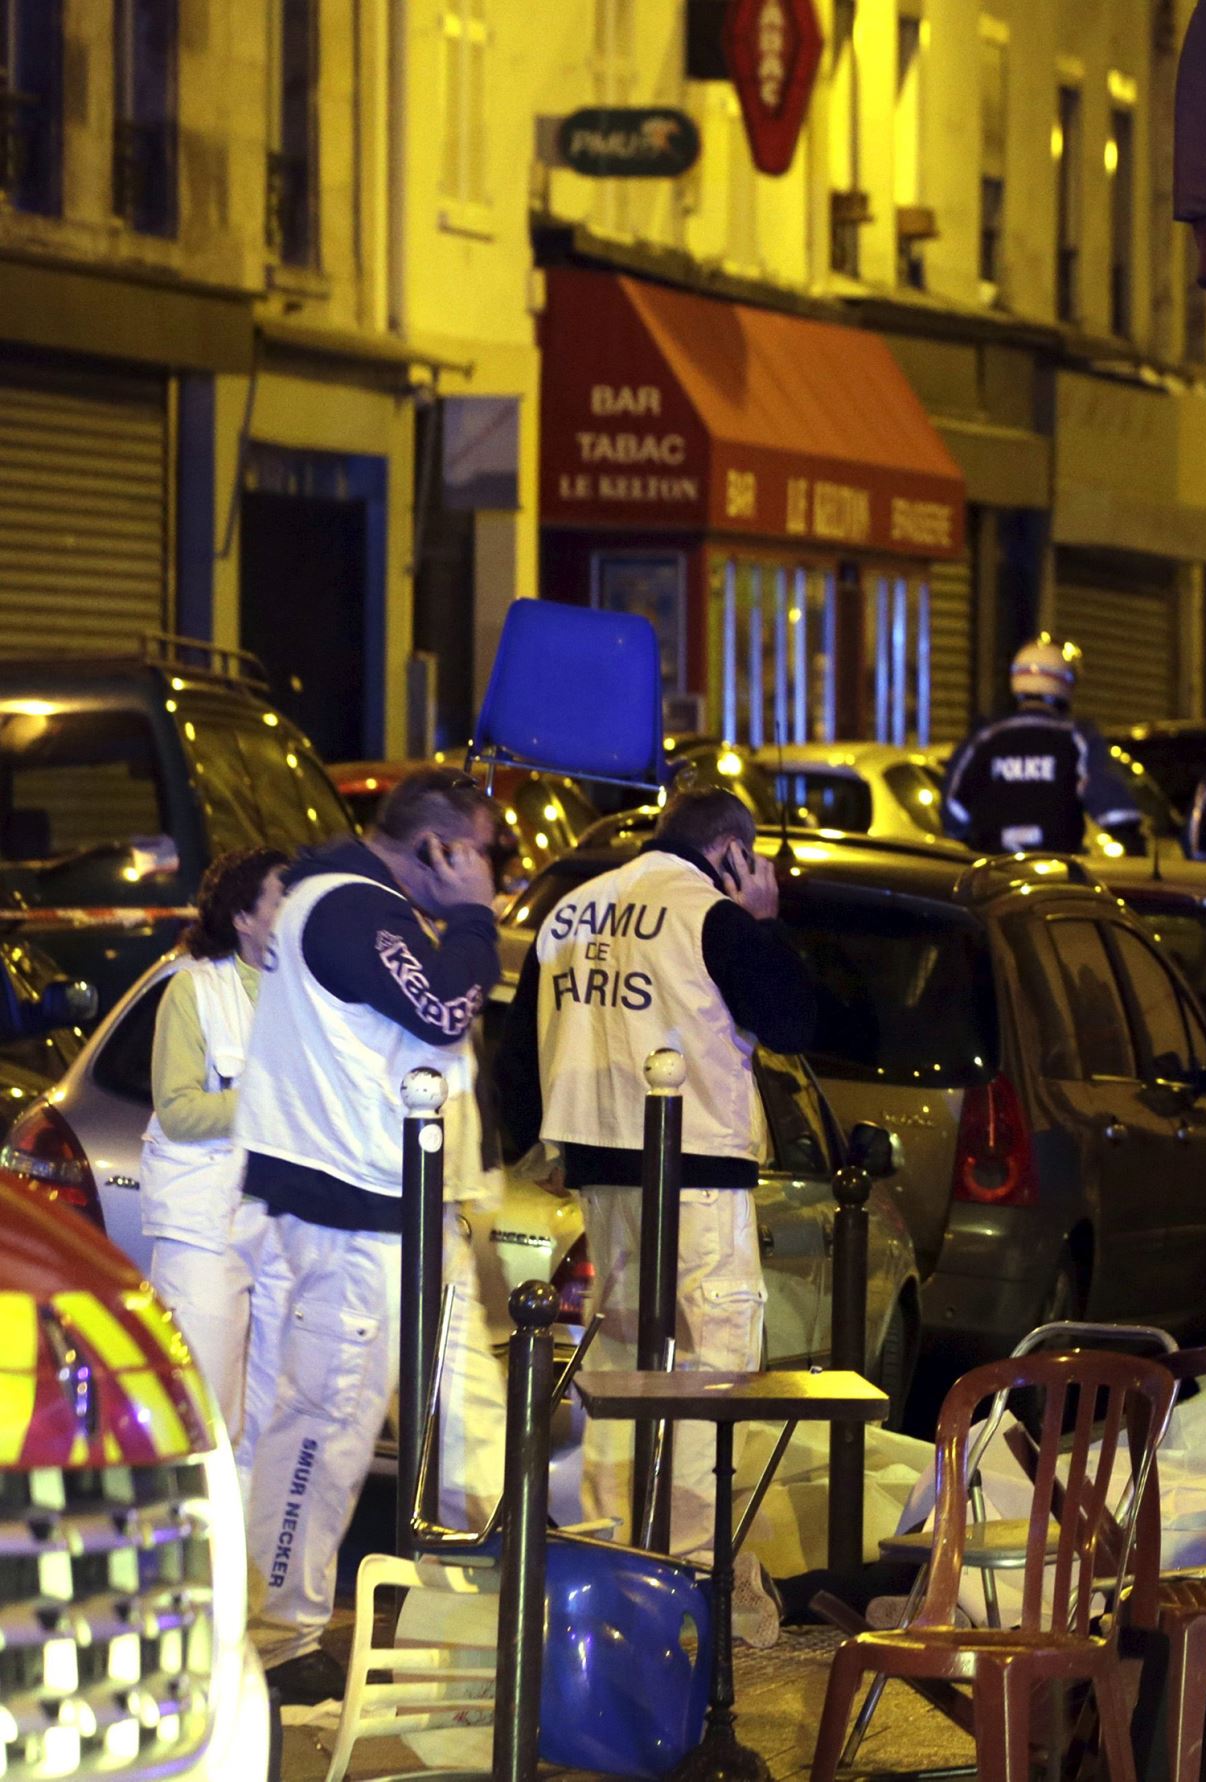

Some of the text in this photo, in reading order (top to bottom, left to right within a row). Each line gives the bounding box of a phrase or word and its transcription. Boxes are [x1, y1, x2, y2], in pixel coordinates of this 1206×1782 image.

[758, 0, 783, 107] ABAC
[590, 384, 662, 417] BAR
[576, 431, 686, 466] TABAC
[990, 755, 1056, 782] POLICE
[551, 901, 667, 940] SAMU
[553, 967, 653, 1011] PARIS
[268, 1438, 318, 1589] SMUR NECKER
